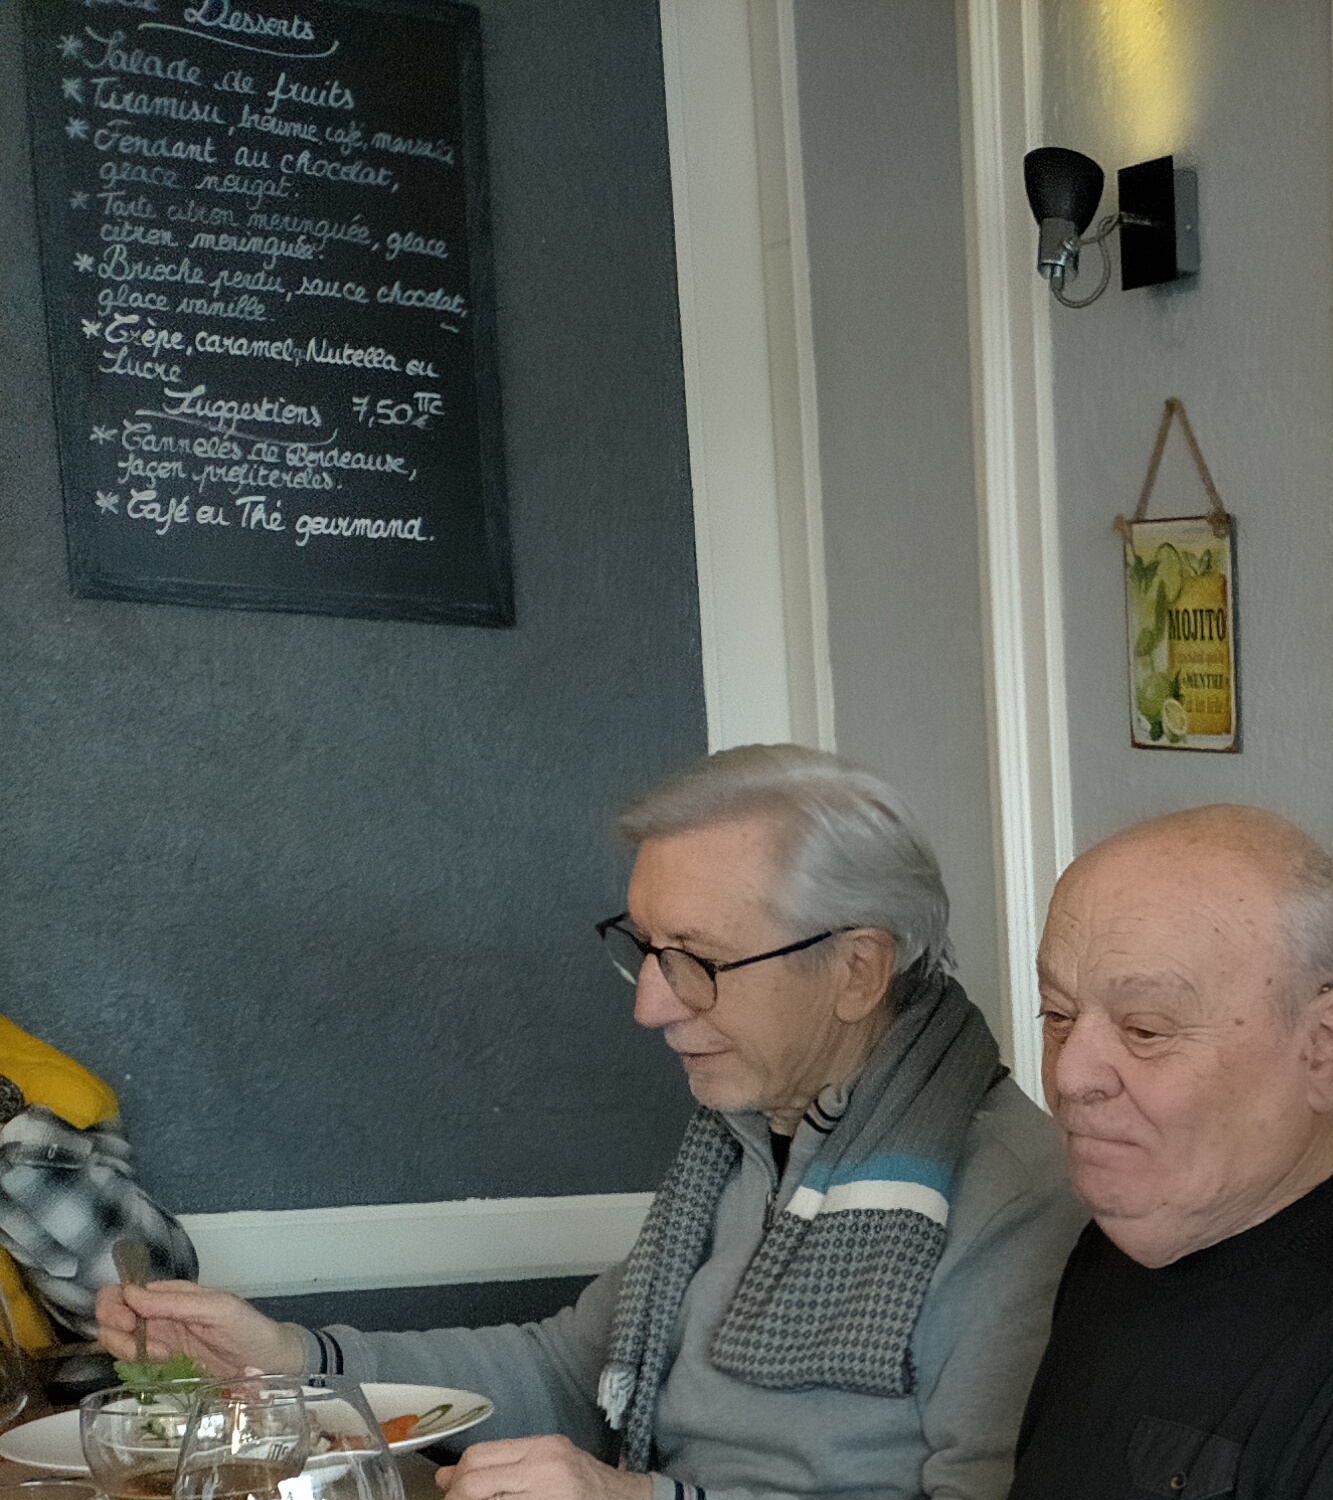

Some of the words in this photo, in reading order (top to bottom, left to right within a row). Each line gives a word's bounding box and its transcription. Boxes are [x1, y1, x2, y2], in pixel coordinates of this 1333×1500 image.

[184, 0, 315, 40] Desserts
[82, 27, 202, 86] Salade
[214, 69, 256, 94] de
[267, 72, 354, 113] fruits
[94, 118, 217, 164] Fondant
[235, 146, 271, 169] au
[280, 150, 399, 193] chocolat,
[97, 190, 156, 219] Tarte
[168, 199, 240, 227] citron
[385, 231, 448, 260] glace
[100, 220, 178, 246] citron
[98, 244, 206, 284] Brioche
[208, 269, 292, 302] perdu,
[295, 276, 369, 303] sauce
[376, 280, 468, 317] chocolat,
[98, 284, 170, 317] glace
[100, 345, 182, 382] Sucre
[306, 336, 401, 372] Nutella
[405, 359, 440, 379] ou
[162, 384, 323, 440] Suggestions
[117, 452, 187, 488] façon
[247, 442, 281, 463] de
[127, 488, 190, 536] Café
[196, 505, 230, 526] ou
[235, 495, 286, 531] Thé
[1168, 608, 1226, 640] MOJITO
